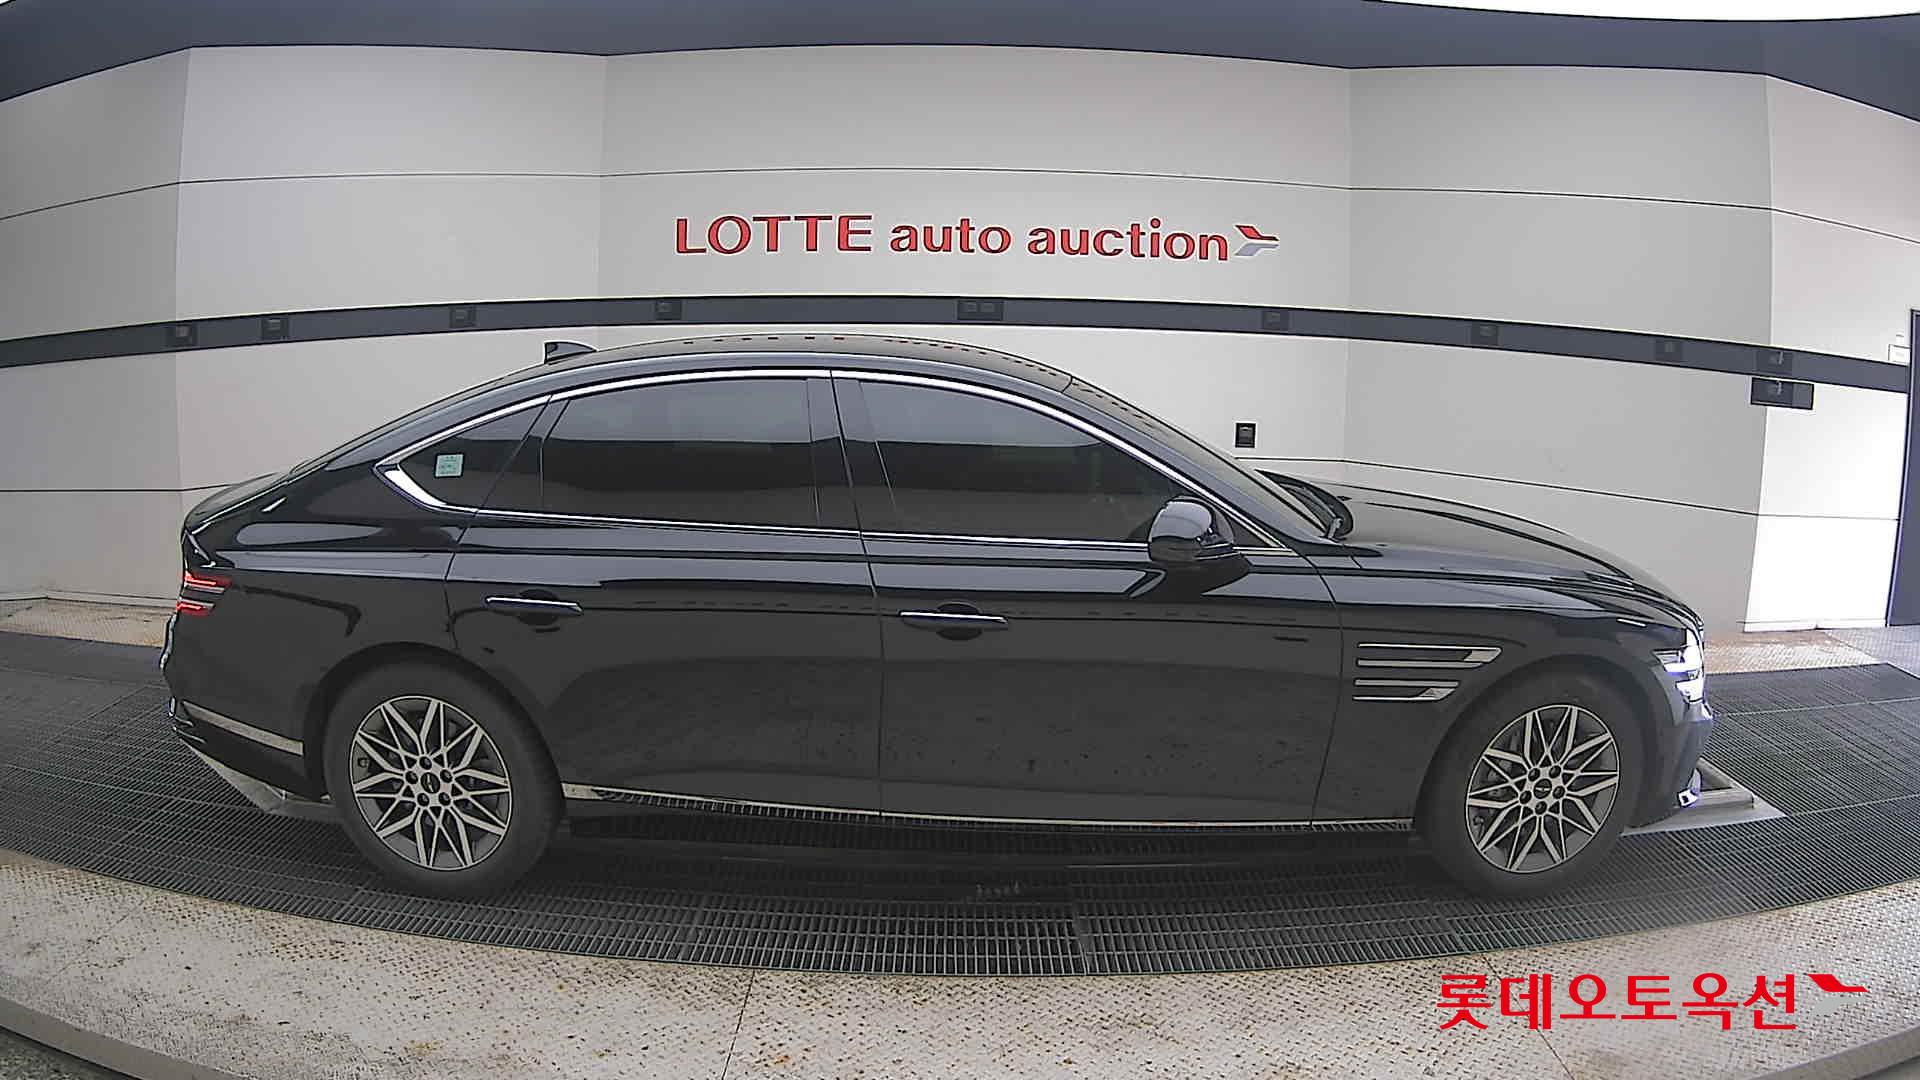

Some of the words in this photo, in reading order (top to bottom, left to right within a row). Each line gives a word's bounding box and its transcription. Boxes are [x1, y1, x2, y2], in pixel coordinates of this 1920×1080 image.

[675, 215, 873, 254] LOTTE
[890, 218, 1012, 253] auto
[1028, 218, 1228, 260] auction
